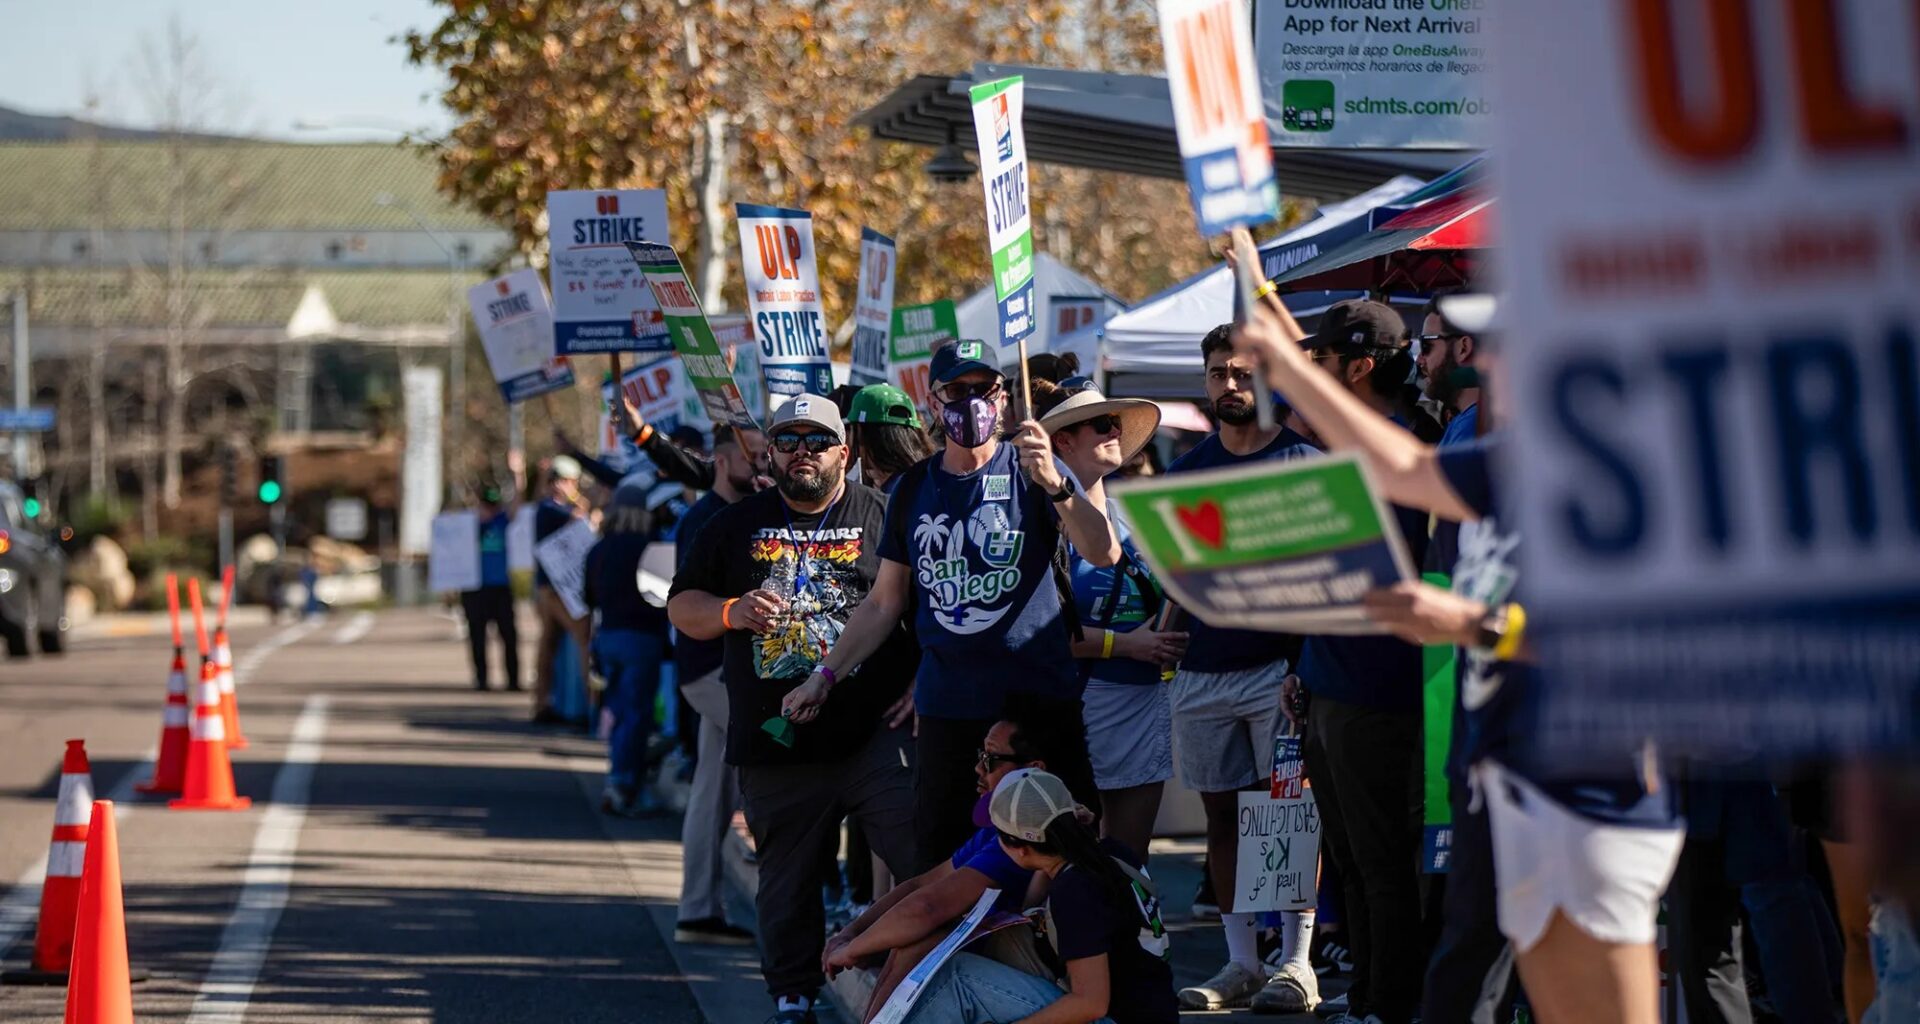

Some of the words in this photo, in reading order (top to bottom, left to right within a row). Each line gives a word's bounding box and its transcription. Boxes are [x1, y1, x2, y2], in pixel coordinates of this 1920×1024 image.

[1393, 0, 1425, 10] the
[1430, 0, 1485, 11] OneB
[1284, 15, 1324, 35] App
[1331, 15, 1358, 32] for
[1365, 16, 1411, 33] Next
[1417, 16, 1481, 34] Arrival
[1282, 43, 1344, 58] Descarga
[1349, 44, 1359, 56] la
[1362, 46, 1388, 59] app
[1282, 60, 1300, 71] los
[1304, 60, 1366, 74] próximos
[1369, 60, 1423, 73] horarios
[1426, 60, 1443, 73] de
[1615, 0, 1920, 176] UL
[1344, 97, 1492, 116] sdmts.com/ob
[991, 161, 1026, 234] STRIKE
[573, 217, 645, 243] STRIKE
[755, 224, 802, 280] ULP
[757, 311, 825, 357] STRIKE
[1547, 322, 1920, 562] STRI
[751, 528, 807, 541] STAR
[806, 527, 863, 541] WARS
[918, 555, 967, 586] San
[933, 568, 1021, 608] Diego
[1275, 760, 1304, 783] STRIKE
[1284, 780, 1301, 798] ULP
[1240, 802, 1320, 837] GASLIGHTING
[1249, 876, 1267, 901] of
[1276, 871, 1307, 903] Tired
